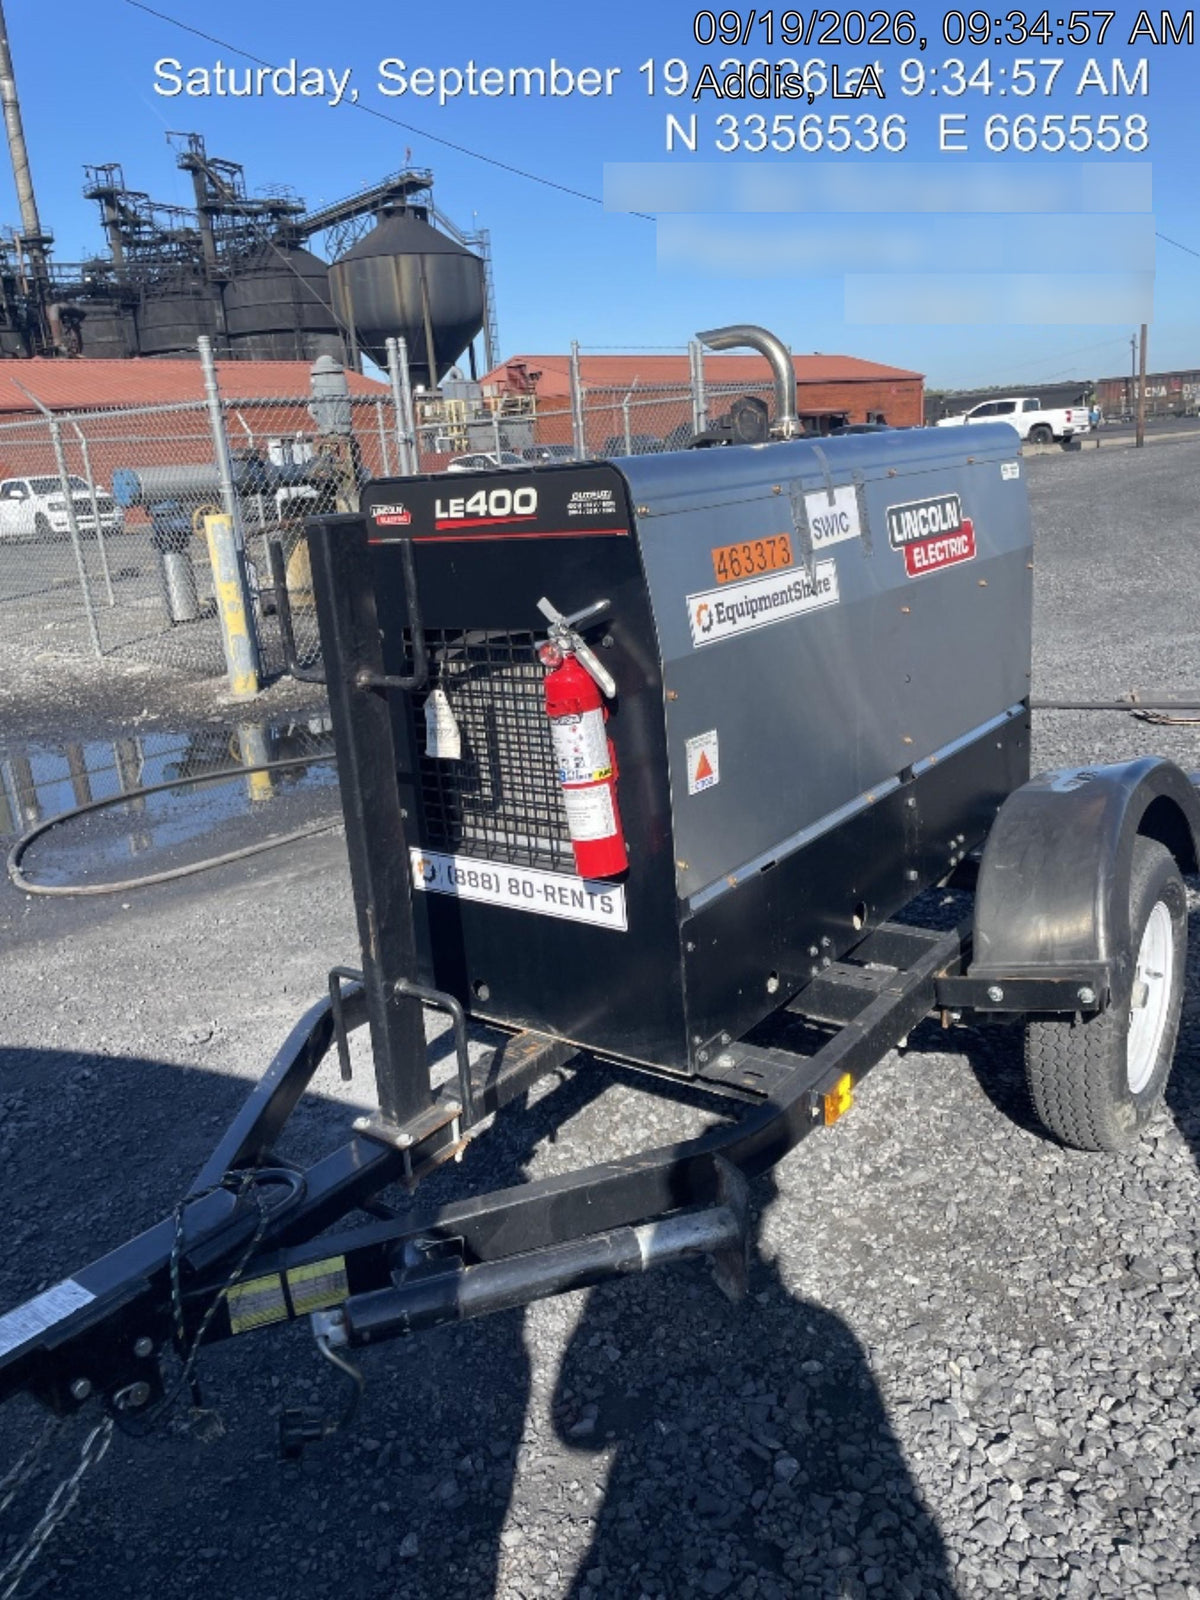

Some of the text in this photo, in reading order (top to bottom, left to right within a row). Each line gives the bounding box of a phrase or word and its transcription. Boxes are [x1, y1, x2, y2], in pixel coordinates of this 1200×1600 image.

[435, 487, 538, 518] LE400
[812, 511, 850, 540] SWIC
[891, 500, 960, 543] LINCOLN
[717, 536, 791, 580] 463373
[912, 534, 970, 569] ELECTRIC
[714, 577, 831, 624] EquipmentShre
[447, 864, 500, 893] (888)
